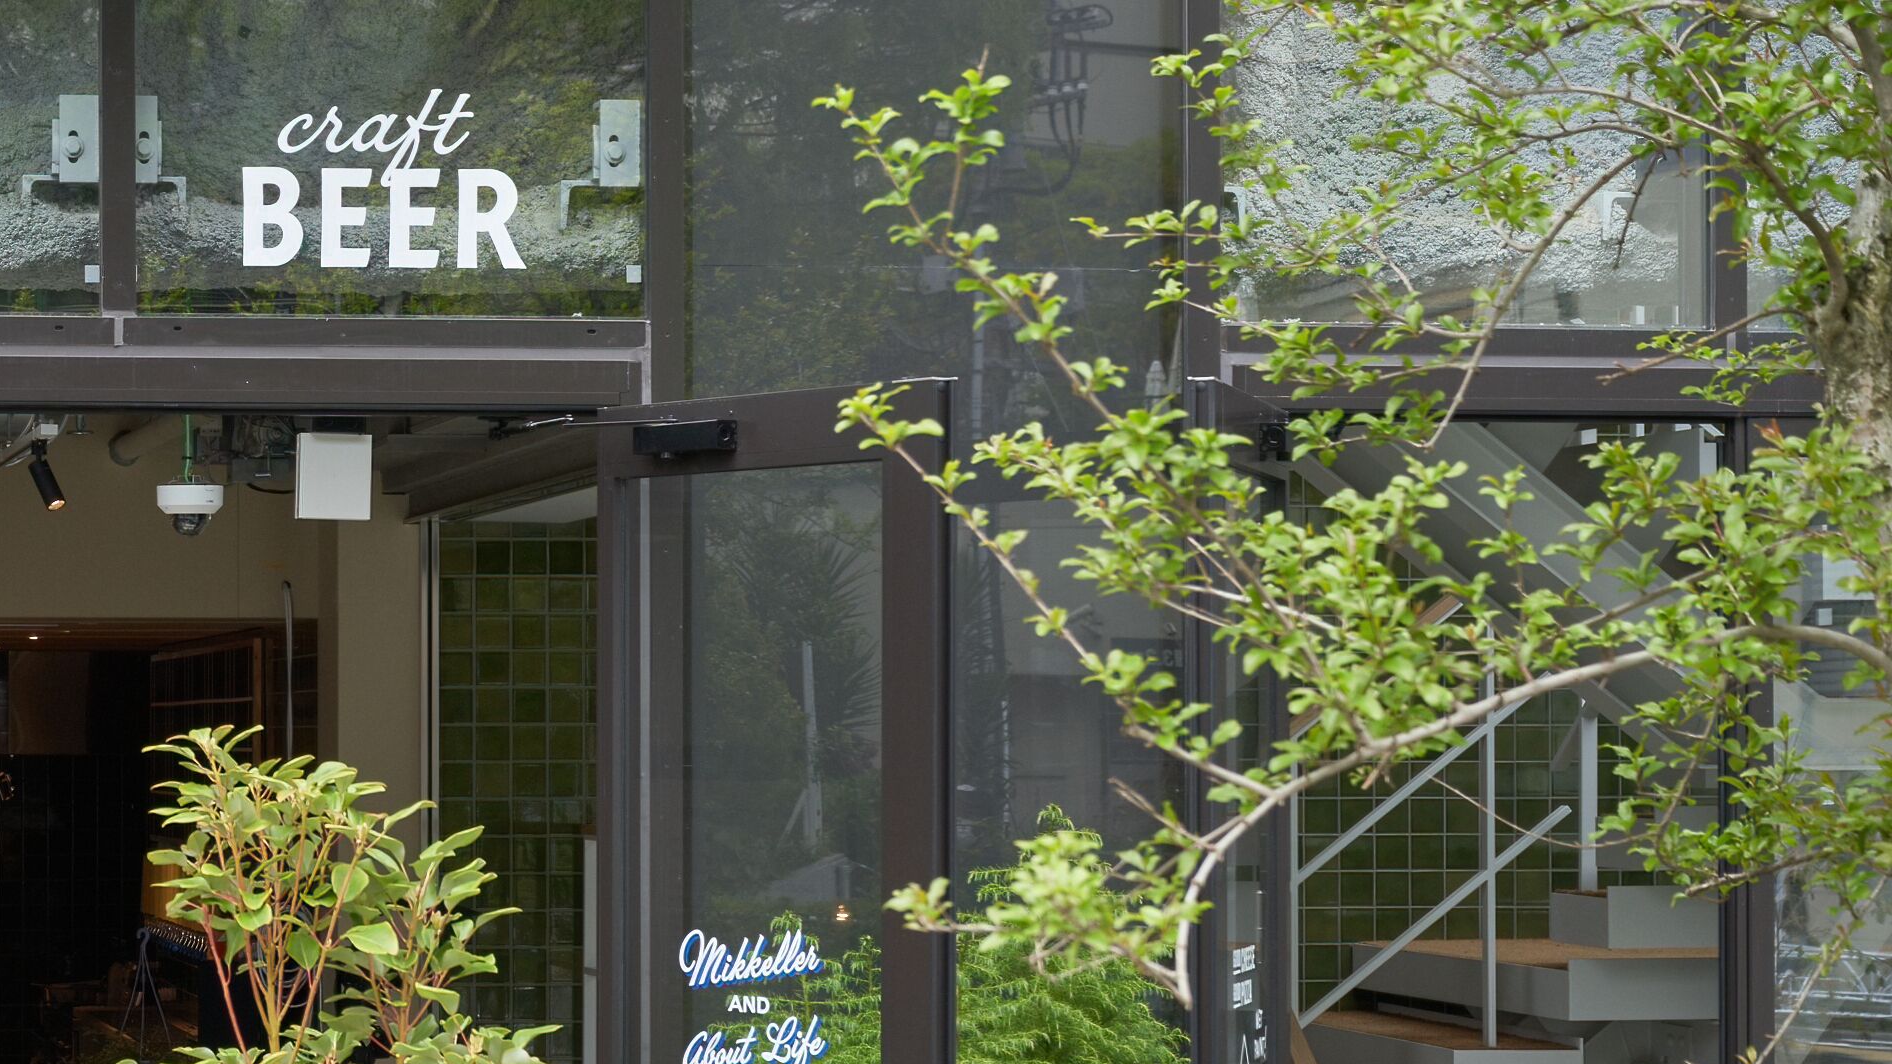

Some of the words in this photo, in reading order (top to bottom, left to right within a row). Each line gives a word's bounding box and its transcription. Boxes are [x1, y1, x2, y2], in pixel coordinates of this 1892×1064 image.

[277, 88, 474, 186] craft
[242, 166, 527, 270] BEER
[679, 928, 824, 990] Mikkeller
[727, 994, 770, 1015] AND
